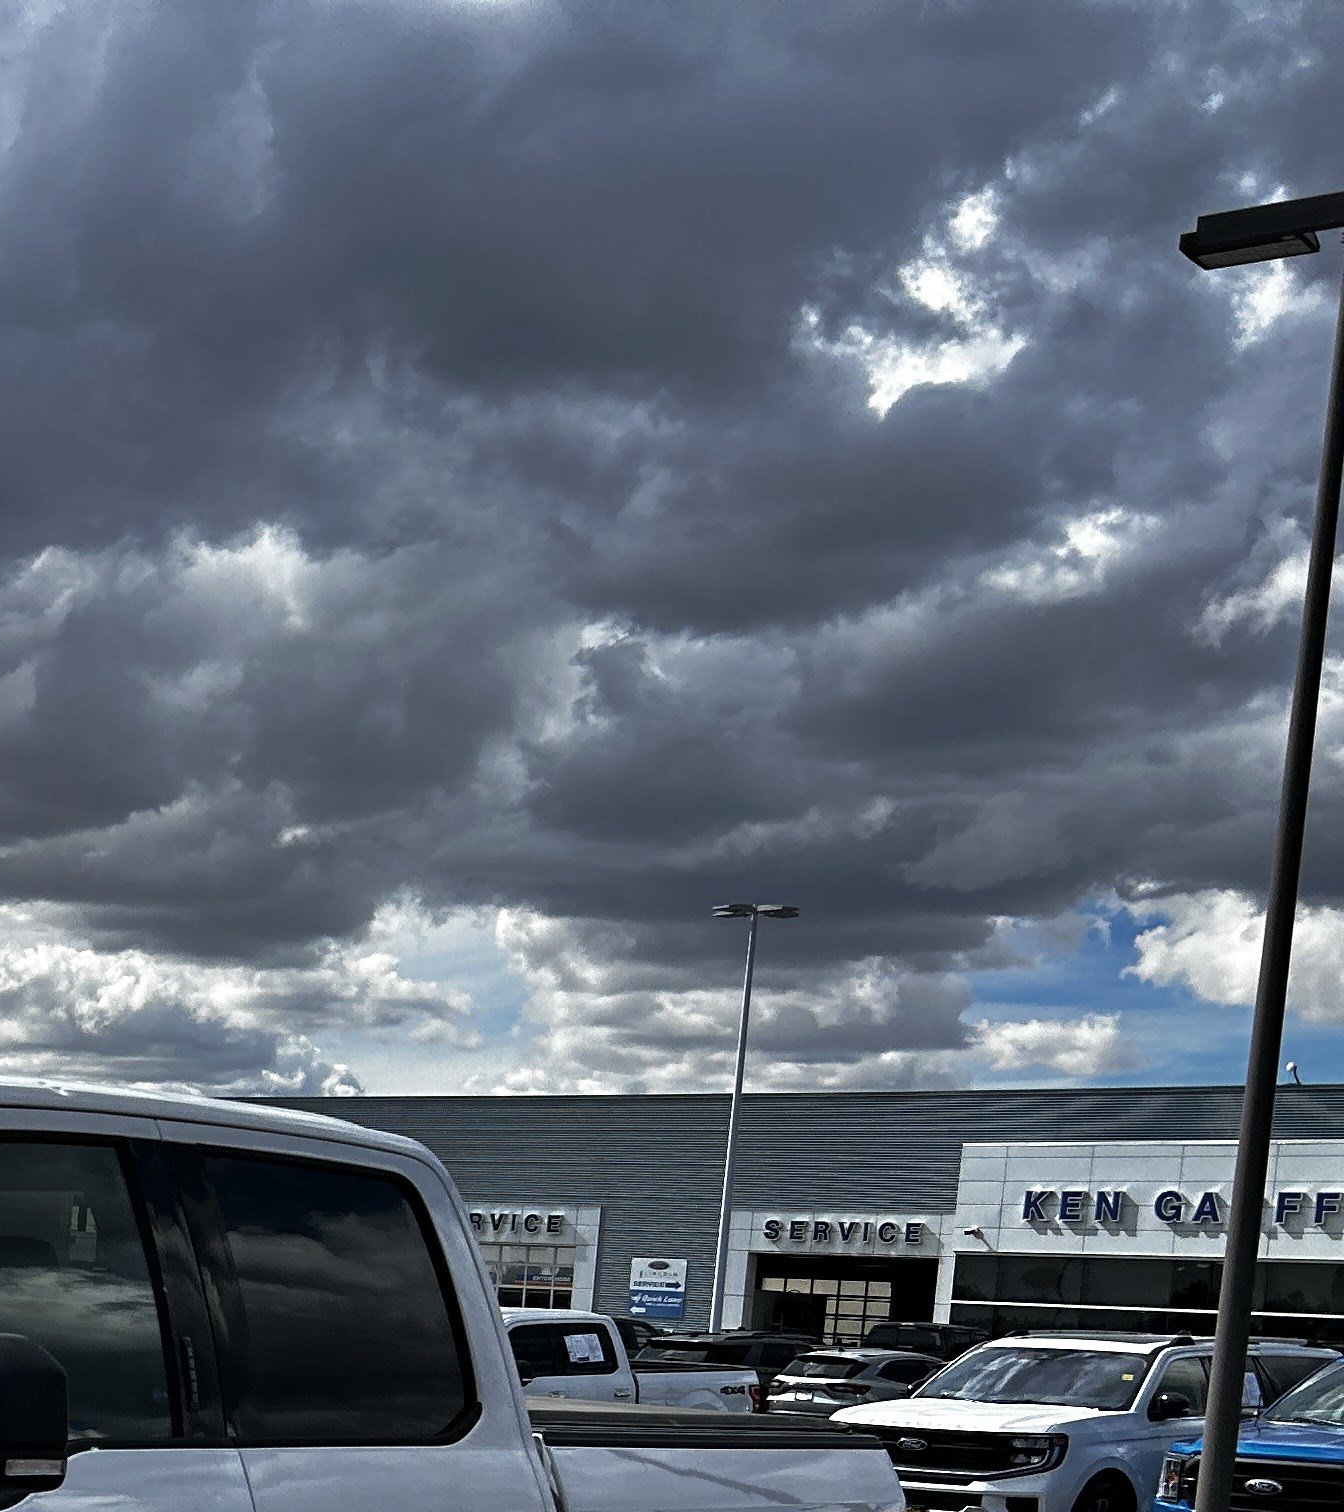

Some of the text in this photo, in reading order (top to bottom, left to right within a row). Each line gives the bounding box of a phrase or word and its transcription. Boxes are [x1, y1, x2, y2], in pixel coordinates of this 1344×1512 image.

[1021, 1190, 1344, 1225] KEN GAFF
[469, 1212, 564, 1233] RVICE
[763, 1219, 924, 1244] SERVICE
